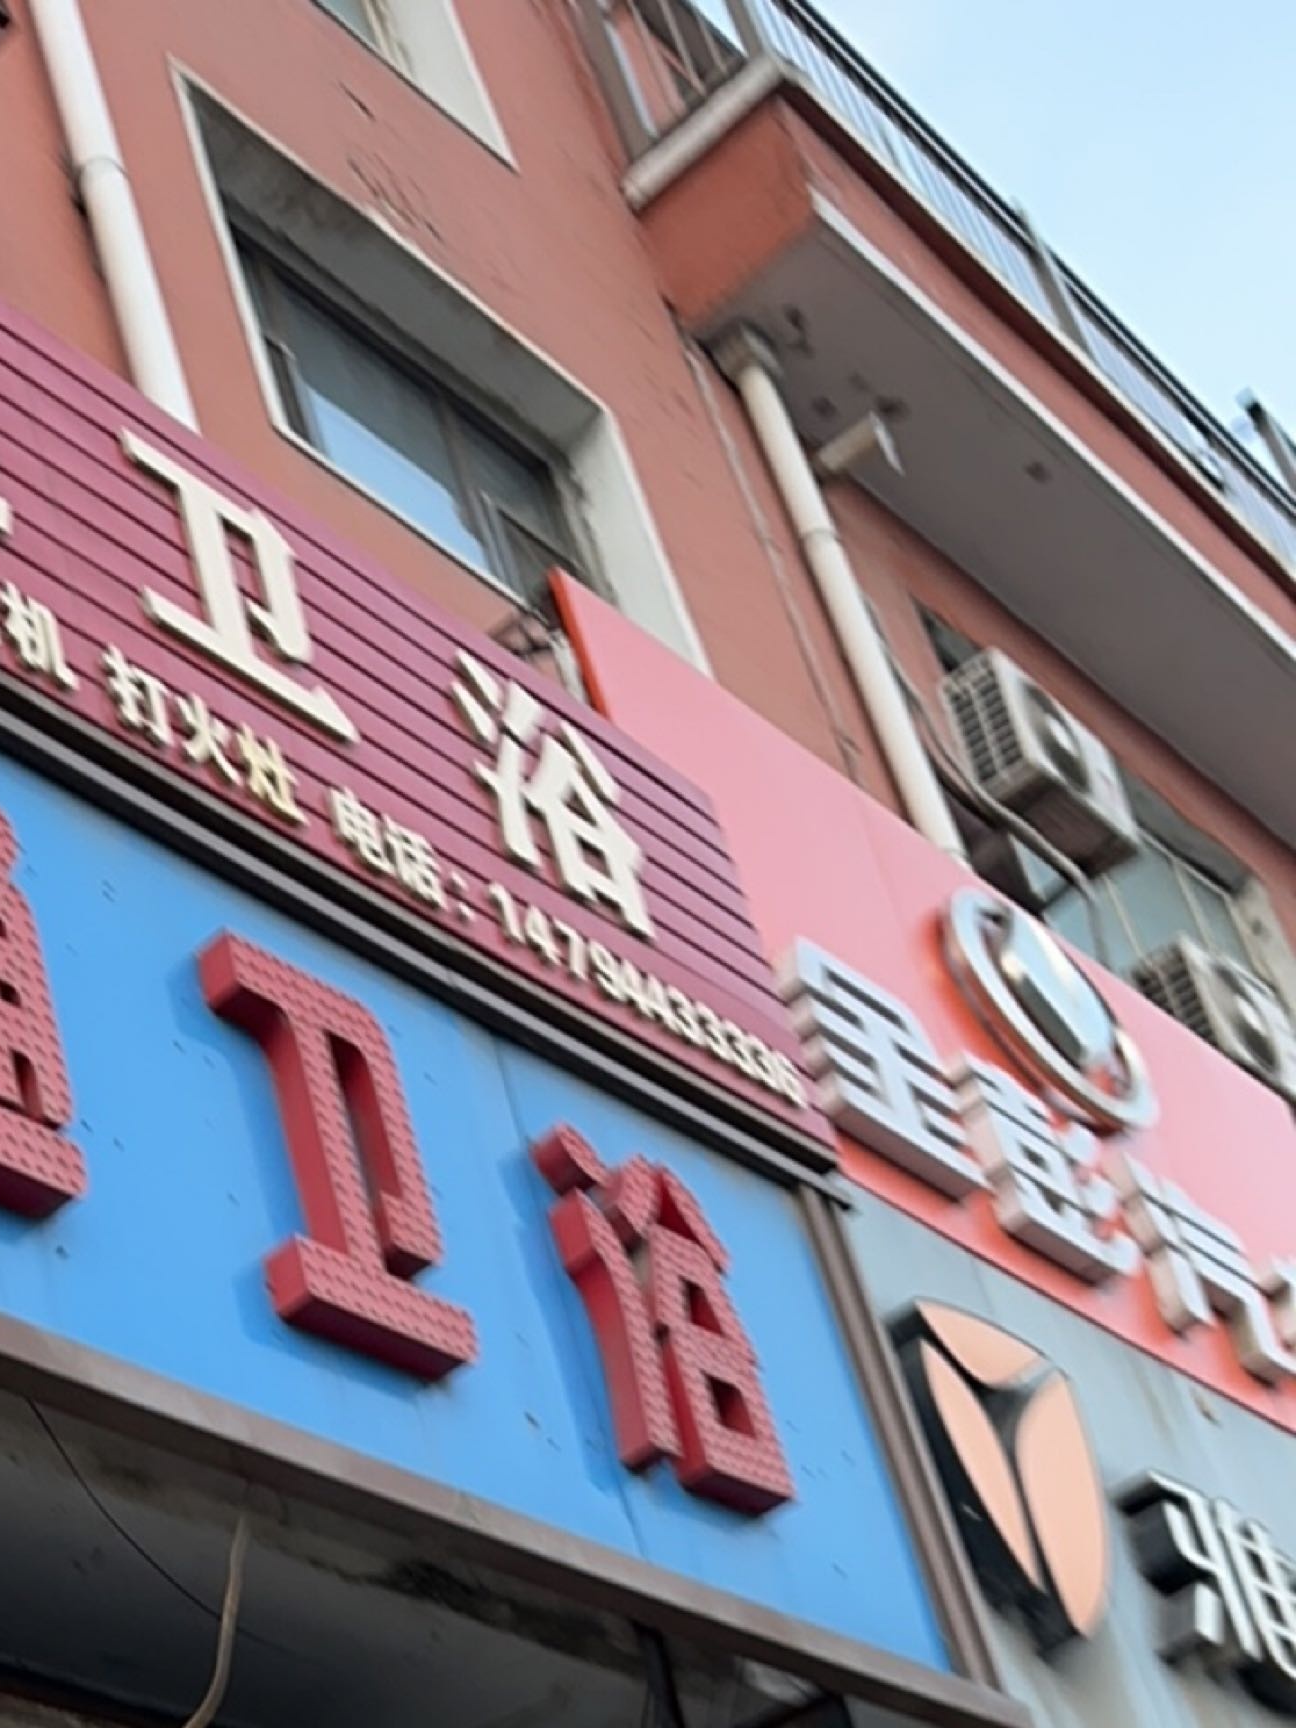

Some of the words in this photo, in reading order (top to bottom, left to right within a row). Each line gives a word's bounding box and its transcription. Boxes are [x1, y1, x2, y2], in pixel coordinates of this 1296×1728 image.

[102, 644, 309, 826] 打火灶
[779, 935, 1296, 1385] 金彭汽
